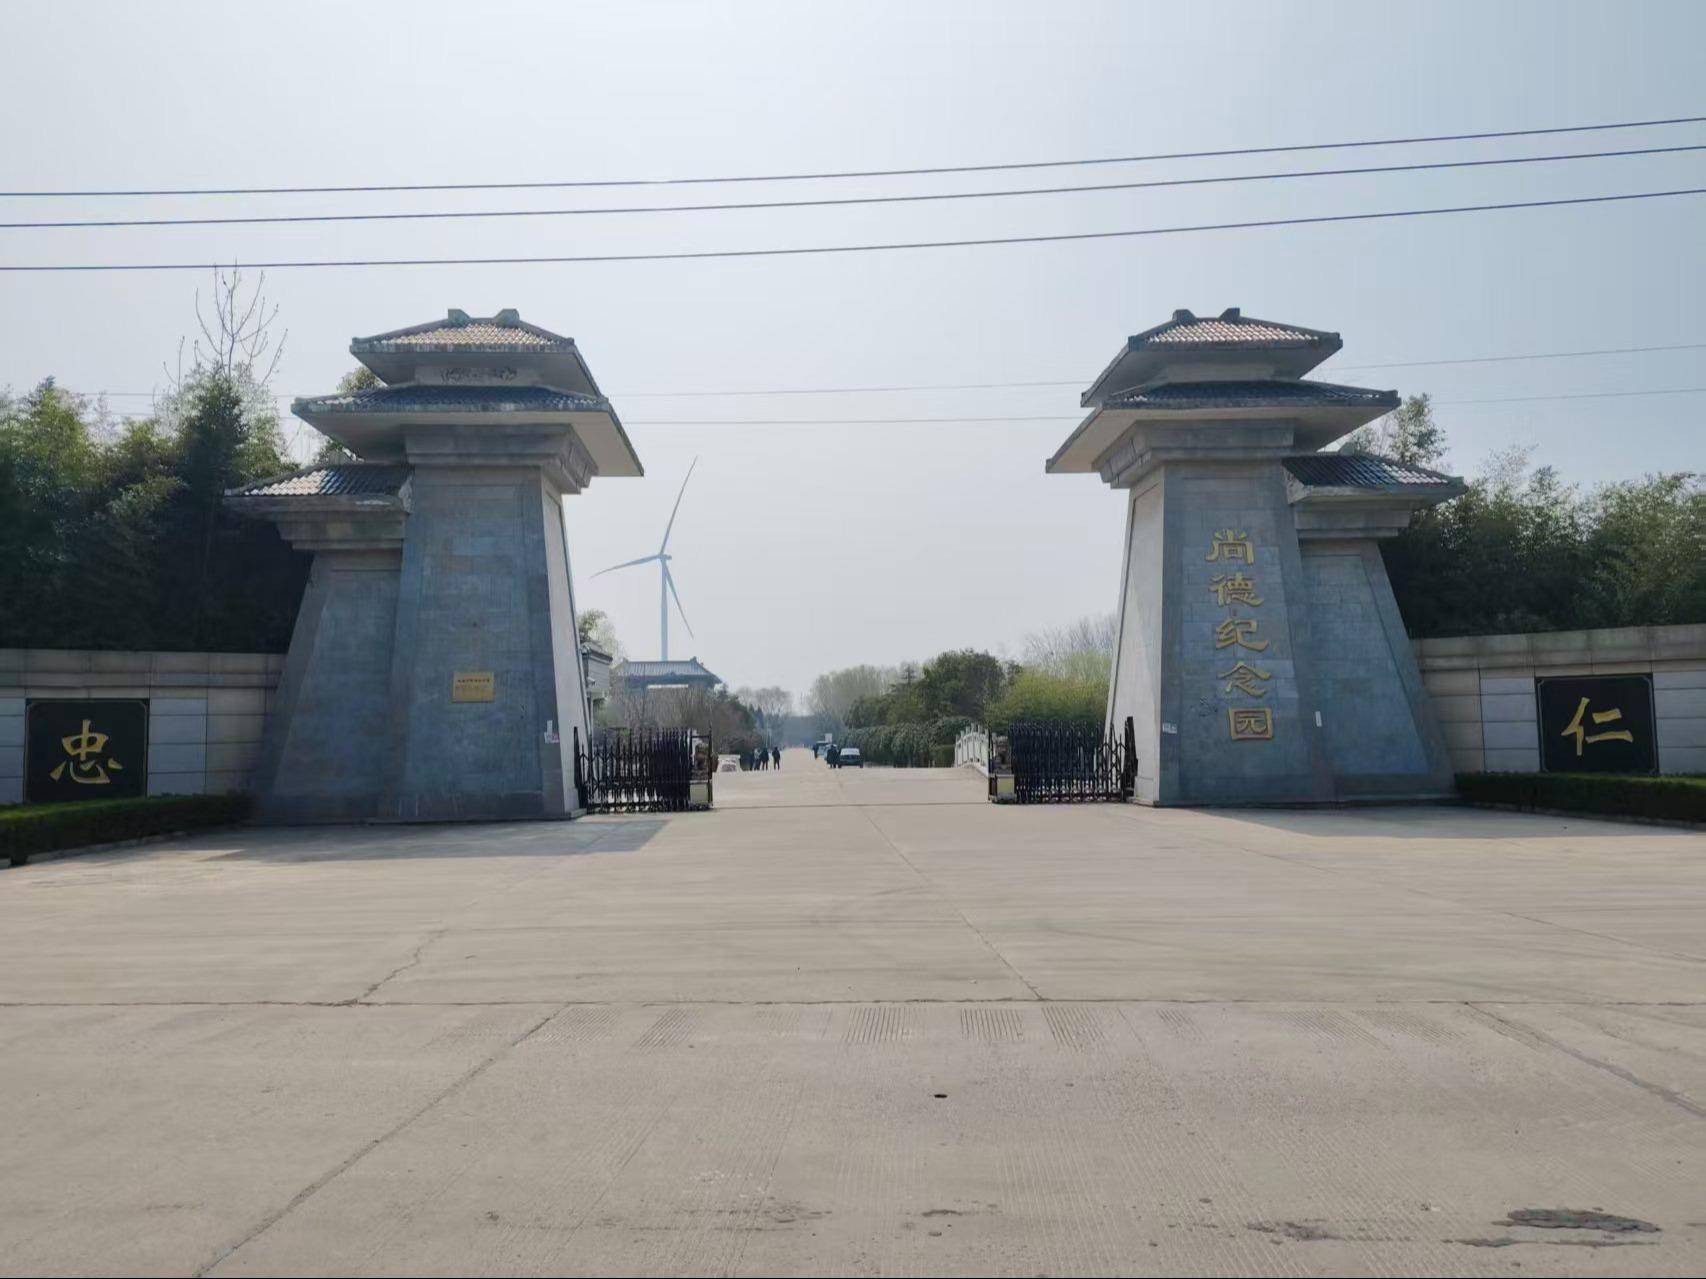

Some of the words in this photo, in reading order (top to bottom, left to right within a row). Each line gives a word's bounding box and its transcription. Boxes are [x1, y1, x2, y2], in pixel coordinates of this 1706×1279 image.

[1205, 529, 1275, 741] 尚德纪念园
[49, 719, 124, 784] 忠
[1561, 696, 1634, 757] 仁
